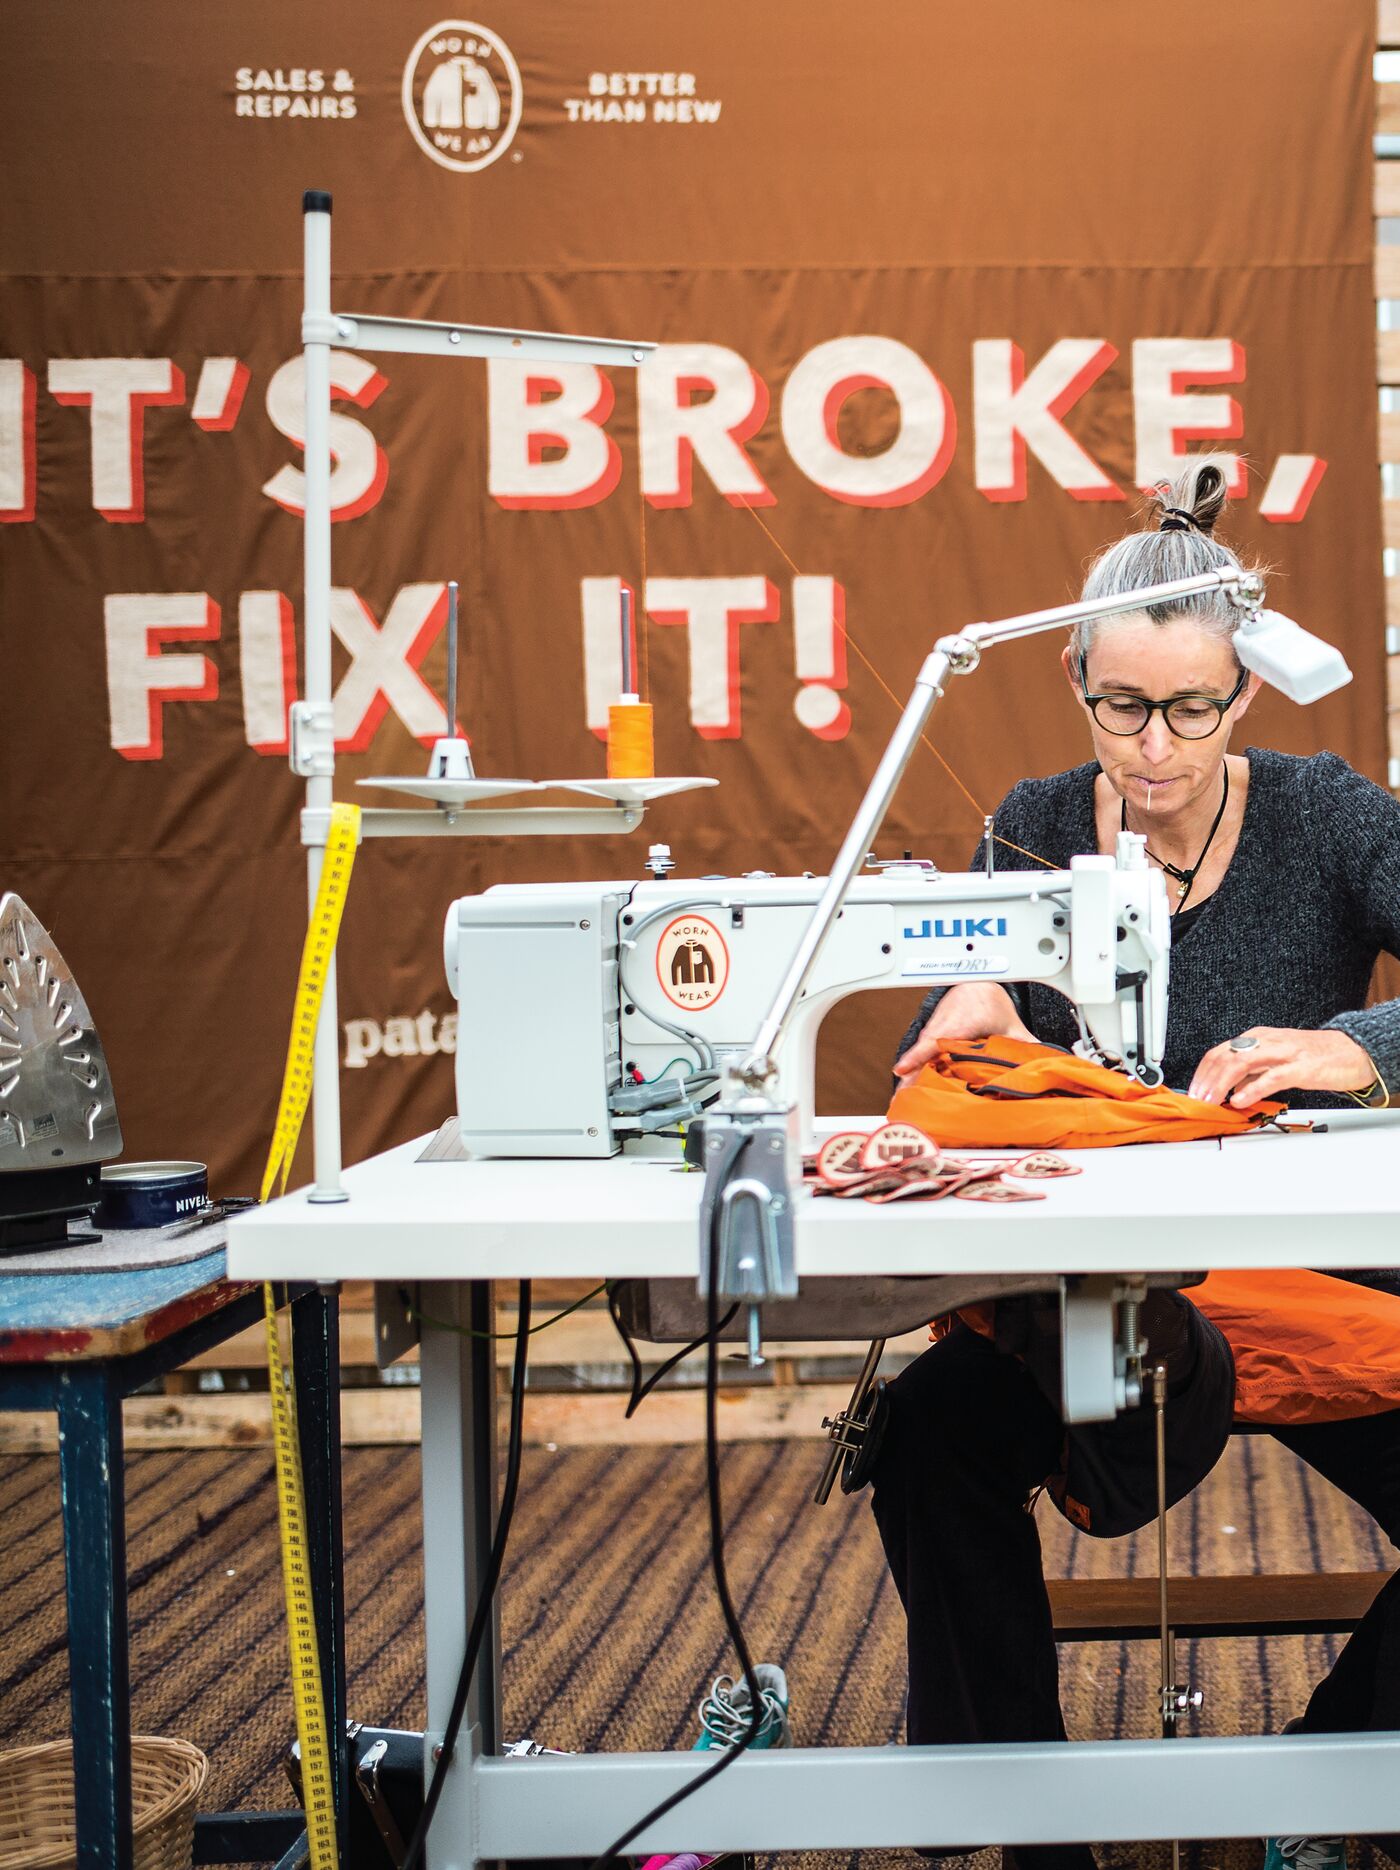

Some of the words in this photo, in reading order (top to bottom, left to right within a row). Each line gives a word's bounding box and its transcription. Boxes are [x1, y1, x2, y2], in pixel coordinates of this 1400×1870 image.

[429, 37, 493, 58] WORN
[236, 68, 324, 92] SALES
[333, 68, 354, 93] &
[588, 73, 696, 96] BETTER
[236, 96, 357, 119] REPAIRS
[563, 99, 646, 122] THAN
[653, 100, 722, 124] NEW
[487, 336, 1327, 525] BROKE,
[104, 582, 470, 760] FIX
[580, 576, 850, 741] IT!
[673, 927, 709, 937] WORN
[904, 918, 1006, 938] JUKI
[679, 990, 711, 1001] WEAR
[344, 1008, 458, 1068] pata
[176, 1194, 206, 1213] NIVEA
[287, 1509, 297, 1517] 138
[288, 1522, 298, 1530] 139
[289, 1536, 300, 1544] 140
[291, 1549, 300, 1557] 141
[291, 1563, 302, 1571] 142
[292, 1577, 304, 1585] 143
[294, 1590, 306, 1598] 144
[295, 1603, 307, 1611] 145
[296, 1616, 308, 1624] 146
[297, 1629, 309, 1637] 147
[299, 1643, 311, 1651] 148
[300, 1656, 313, 1664] 149
[302, 1669, 314, 1677] 150
[303, 1682, 315, 1690] 151
[304, 1695, 317, 1704] 152
[305, 1709, 318, 1717] 153
[306, 1722, 319, 1730] 154
[307, 1735, 320, 1744] 155
[309, 1748, 321, 1756] 156
[310, 1761, 323, 1769] 157
[311, 1774, 324, 1783] 158
[312, 1787, 325, 1796] 159
[314, 1800, 326, 1809] 160
[315, 1814, 327, 1822] 161
[316, 1826, 329, 1836] 162
[317, 1839, 330, 1848] 163
[319, 1852, 331, 1861] 164
